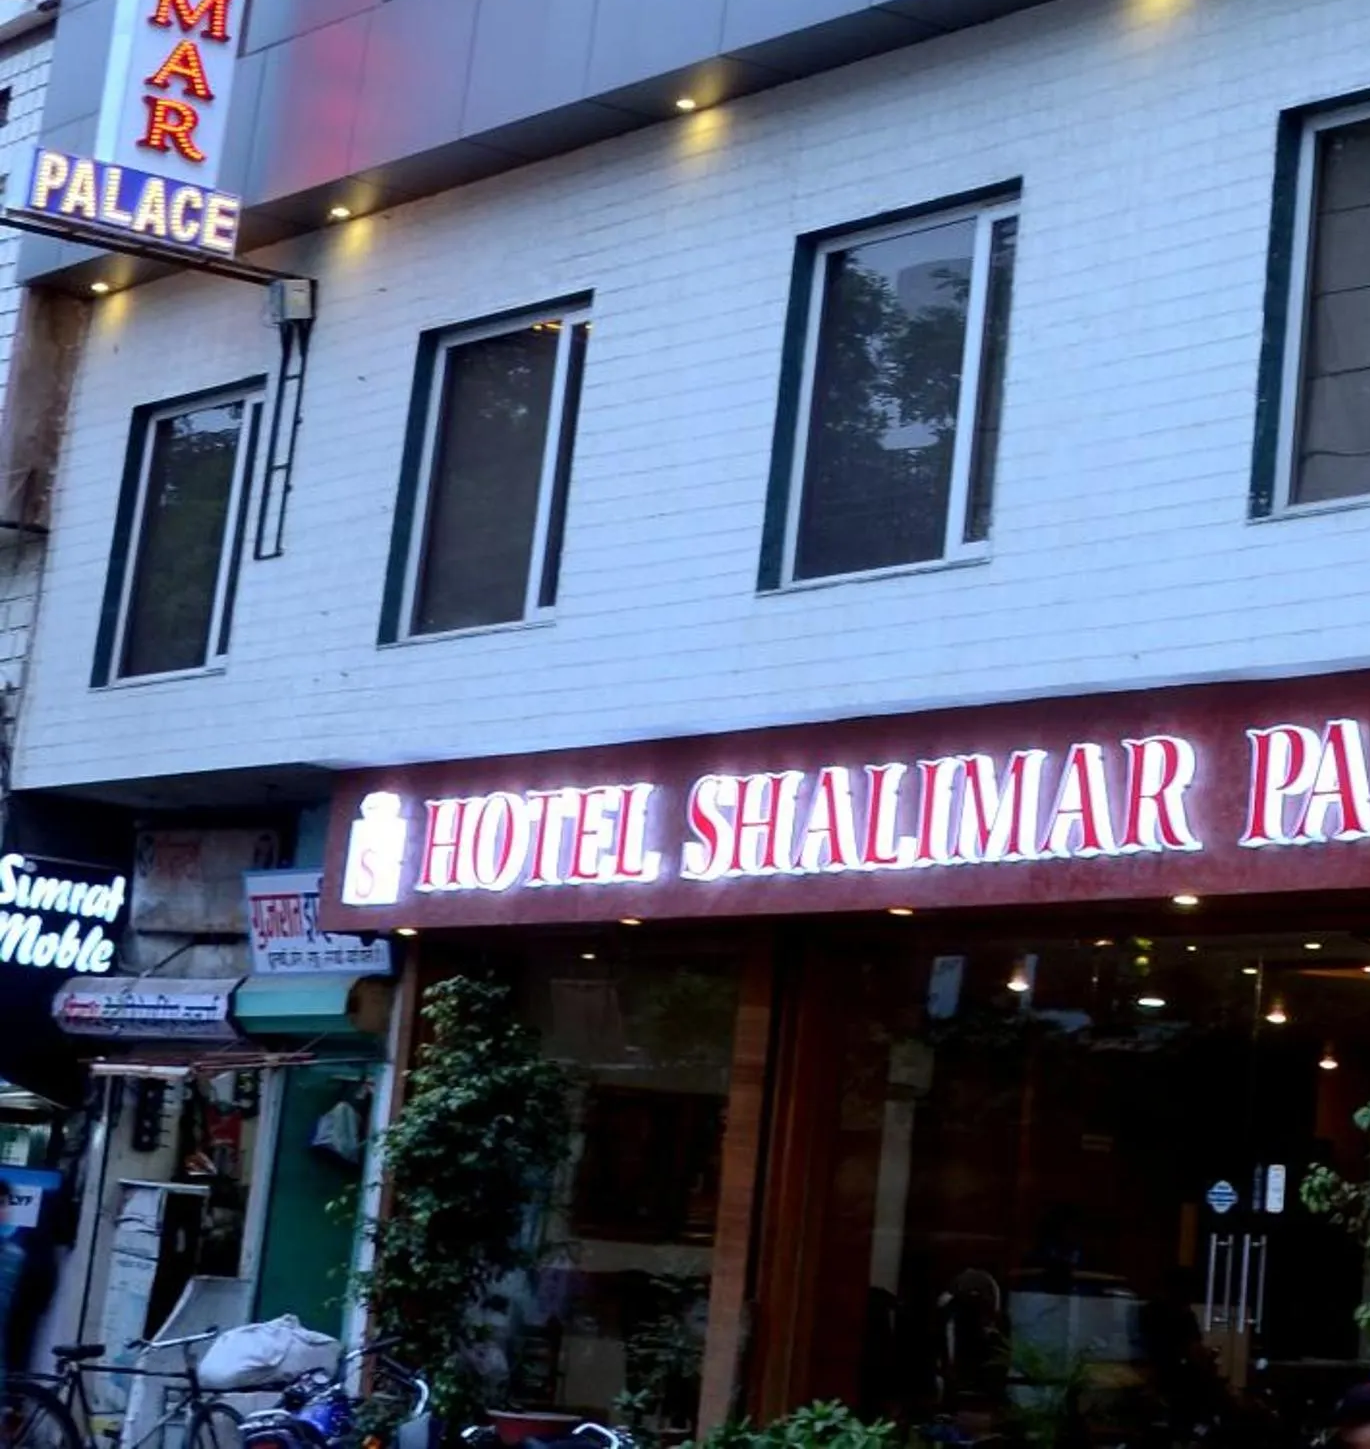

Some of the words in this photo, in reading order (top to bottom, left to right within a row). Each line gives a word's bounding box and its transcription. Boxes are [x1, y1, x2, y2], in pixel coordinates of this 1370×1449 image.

[30, 151, 240, 254] PALACE
[414, 782, 661, 894] HOTEL
[680, 735, 1203, 883] SHALIMAR
